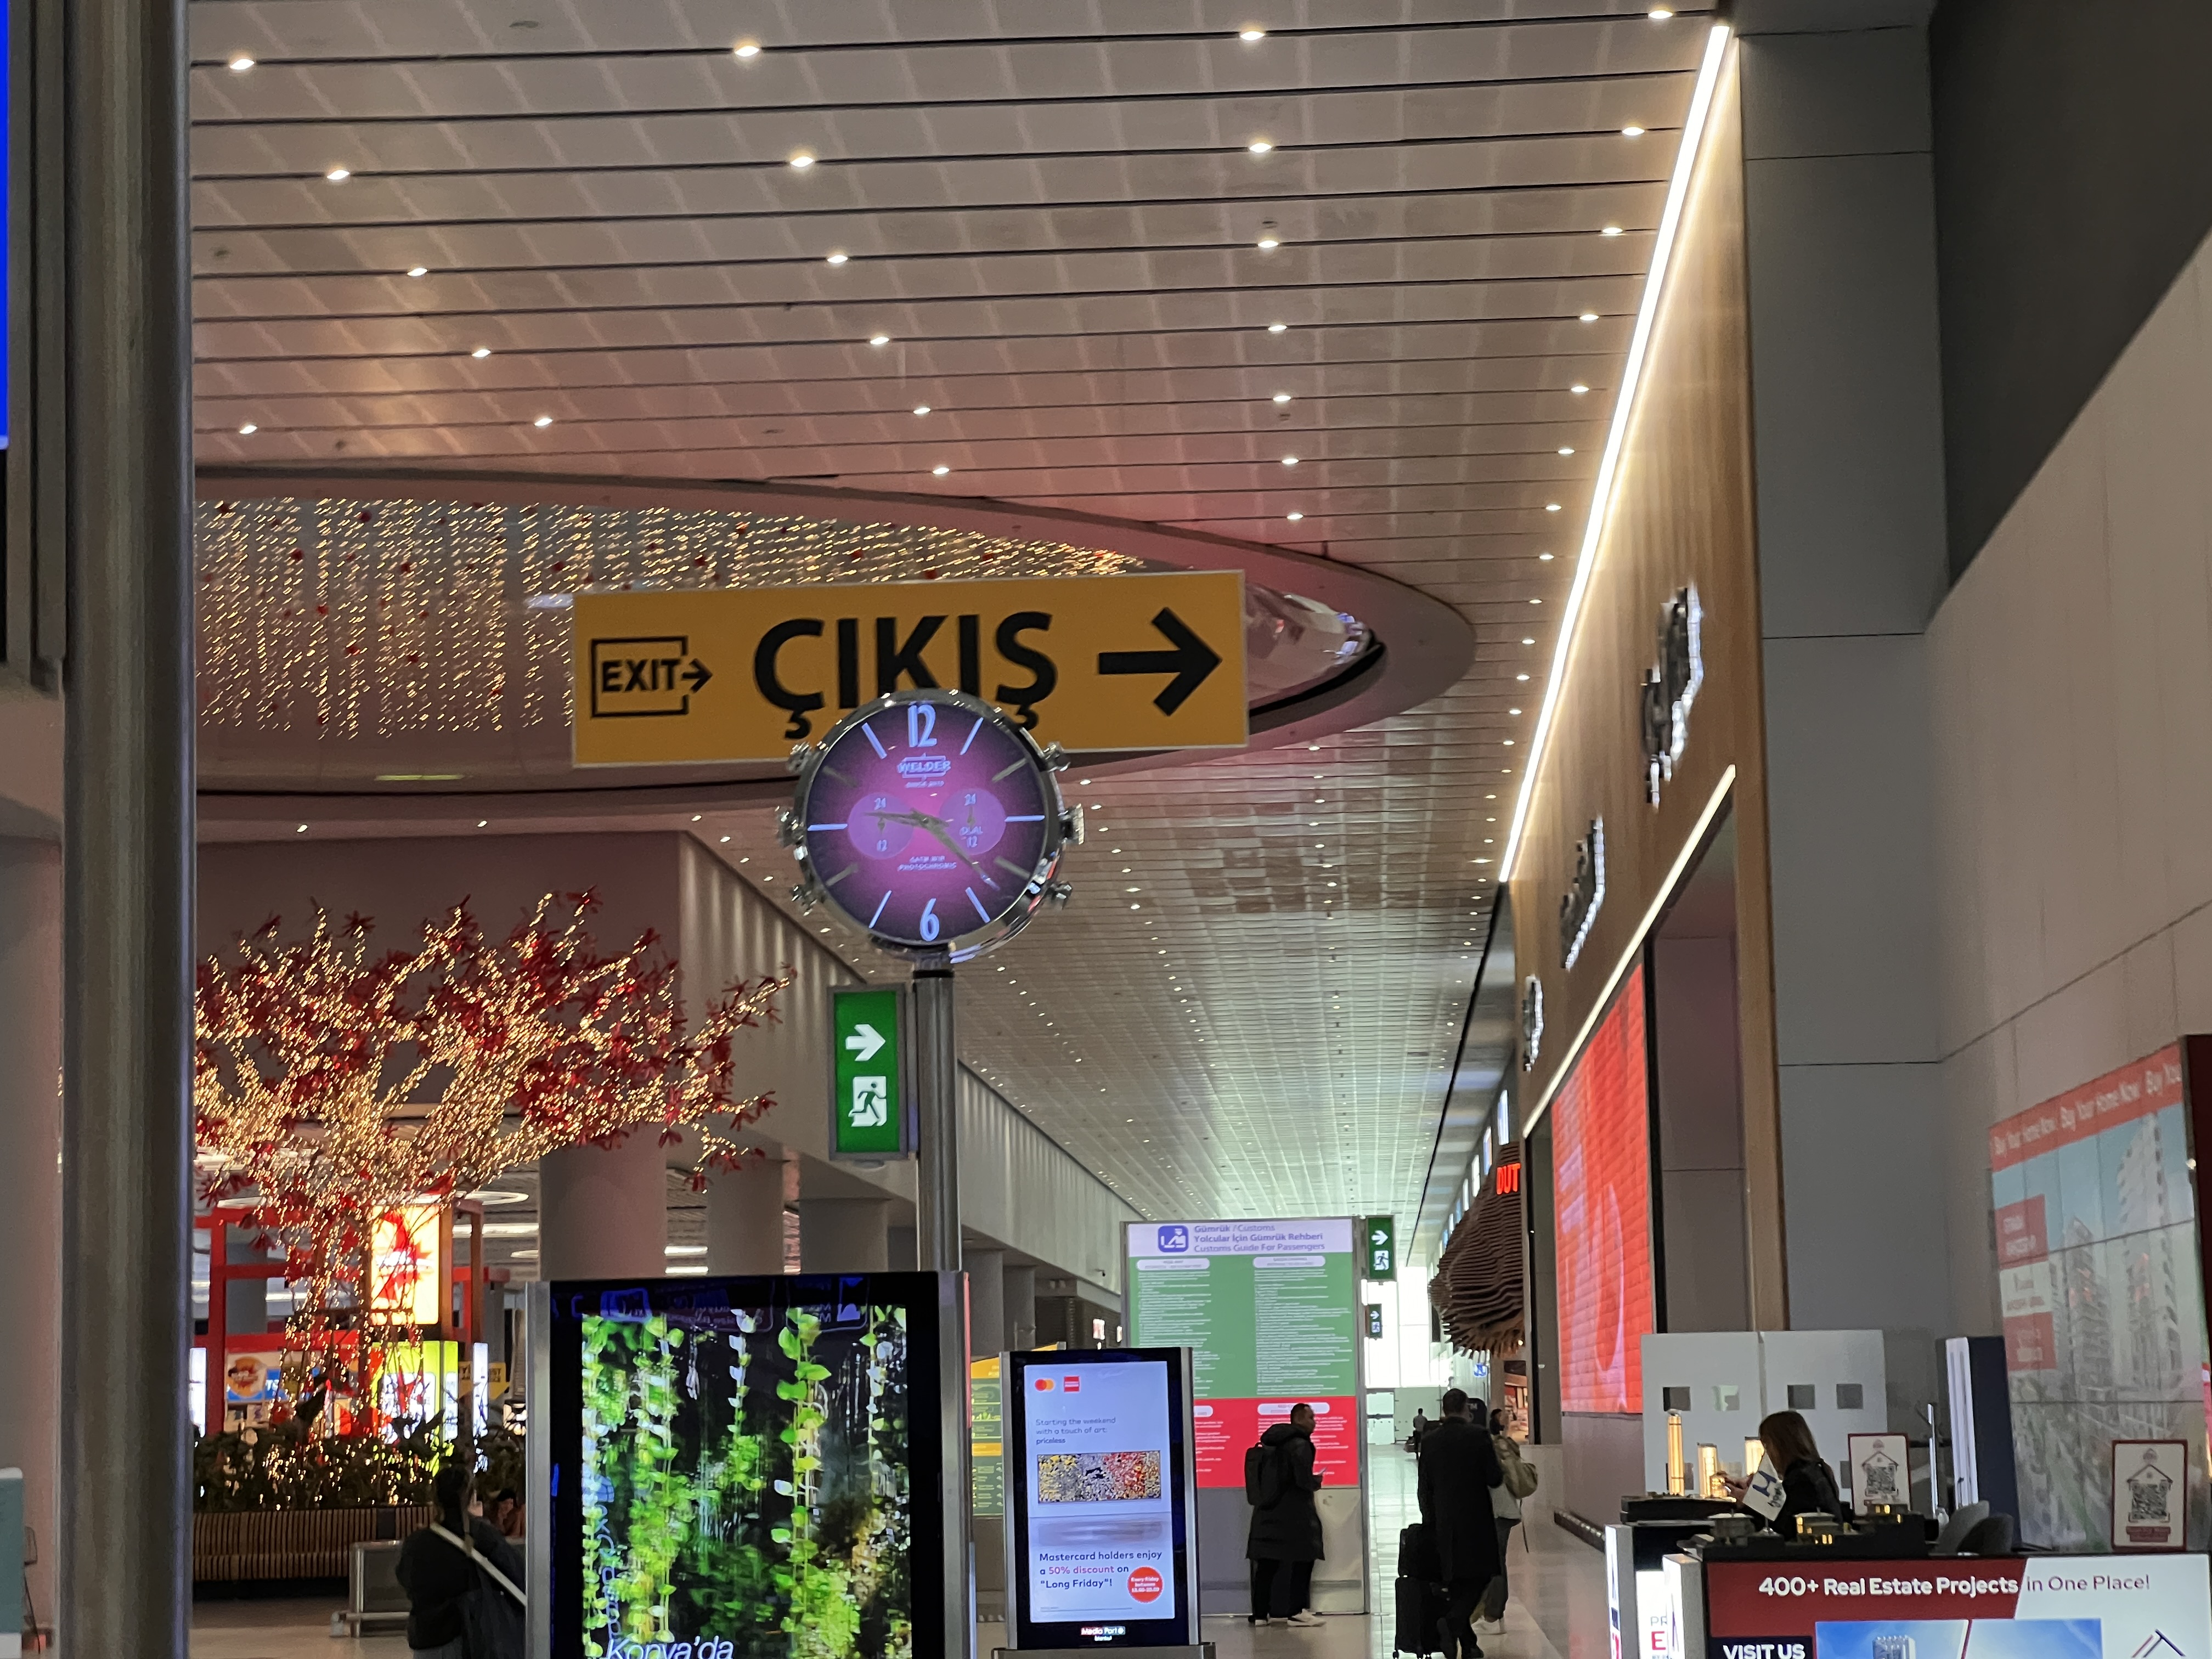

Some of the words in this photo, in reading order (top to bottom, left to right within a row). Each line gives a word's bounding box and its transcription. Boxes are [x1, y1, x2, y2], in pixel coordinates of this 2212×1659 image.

[602, 660, 680, 692] EXIT
[754, 611, 1058, 740] ÇIKIŞ
[907, 704, 937, 748] 12
[919, 898, 940, 941] 6
[1194, 1224, 1231, 1233] Gümrük
[1194, 1234, 1230, 1243] Yolcular
[1250, 1233, 1286, 1242] Gümrük
[1288, 1233, 1323, 1241] Rehberi
[1234, 1244, 1260, 1252] Guide
[1262, 1243, 1276, 1251] For
[1278, 1243, 1325, 1252] Passengers
[1035, 1419, 1067, 1427] Starting
[1036, 1437, 1066, 1446] priceless
[1039, 1552, 1096, 1561] Mastercard
[1098, 1551, 1134, 1560] holders
[1137, 1550, 1163, 1560] enjoy
[1048, 1566, 1071, 1575] 50%
[1073, 1565, 1115, 1574] discount
[1758, 1576, 1819, 1596] 400+
[1824, 1577, 1865, 1596] Real
[1869, 1577, 1933, 1595] Estate
[1936, 1575, 2019, 1598] Projects
[2027, 1576, 2044, 1592] in
[2048, 1575, 2088, 1591] One
[2093, 1574, 2151, 1590] Place!
[1723, 1644, 1775, 1659] VISIT
[1777, 1644, 1805, 1659] US
